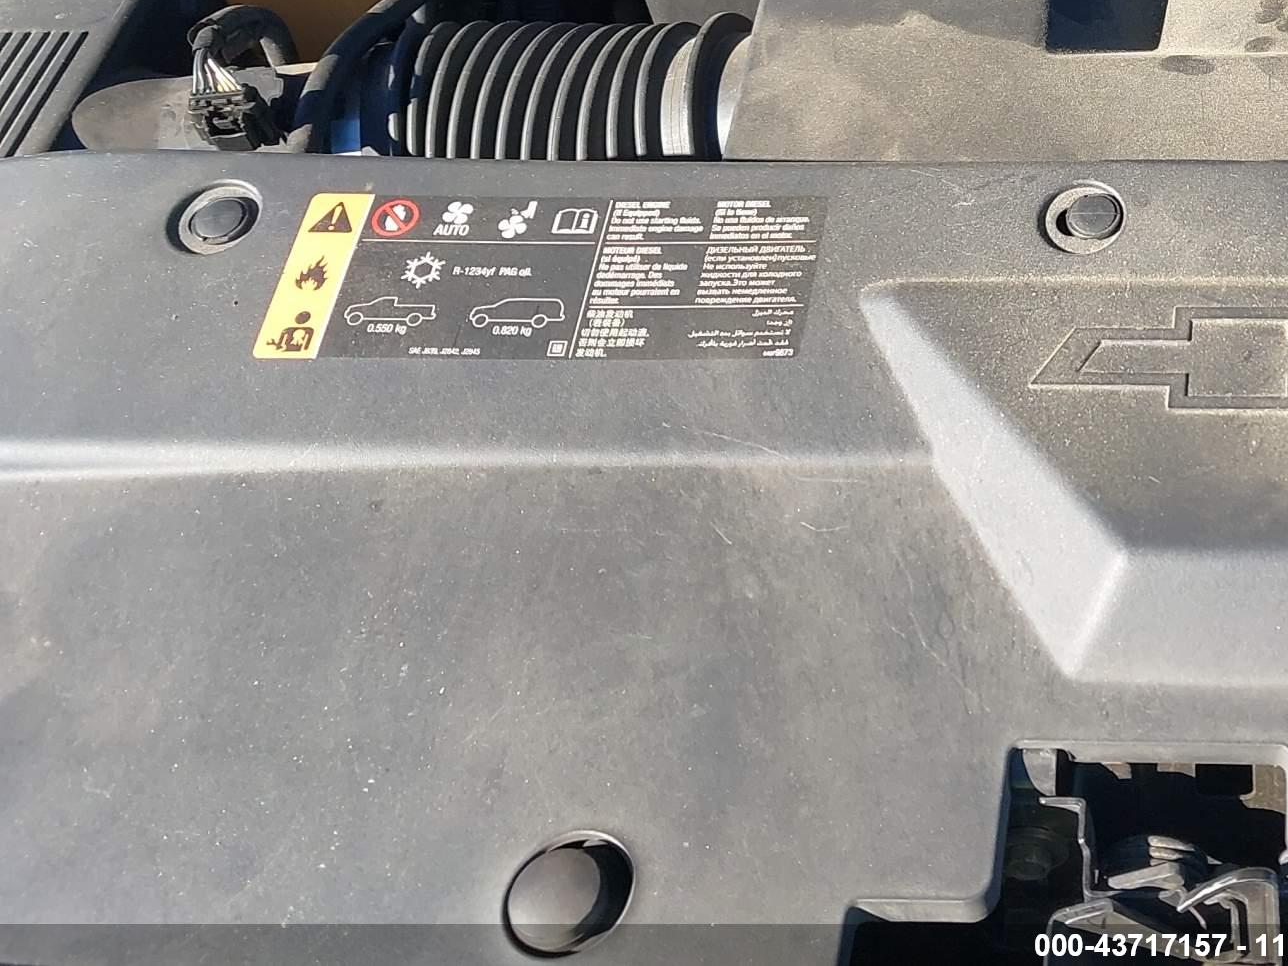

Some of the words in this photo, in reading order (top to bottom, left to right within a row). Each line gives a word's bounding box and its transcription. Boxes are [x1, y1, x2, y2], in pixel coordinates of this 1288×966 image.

[433, 224, 470, 236] AUTO
[602, 246, 635, 254] MOTEUR
[705, 245, 758, 254] ДИЗЕЛЬНЫЙ
[759, 245, 805, 254] ДВИГАТЕЛЬ
[452, 266, 496, 277] R-1234yf
[498, 267, 518, 276] PAG
[367, 324, 393, 333] 0.550
[394, 324, 407, 335] kg
[492, 325, 519, 335] 0.820
[519, 326, 532, 337] kg
